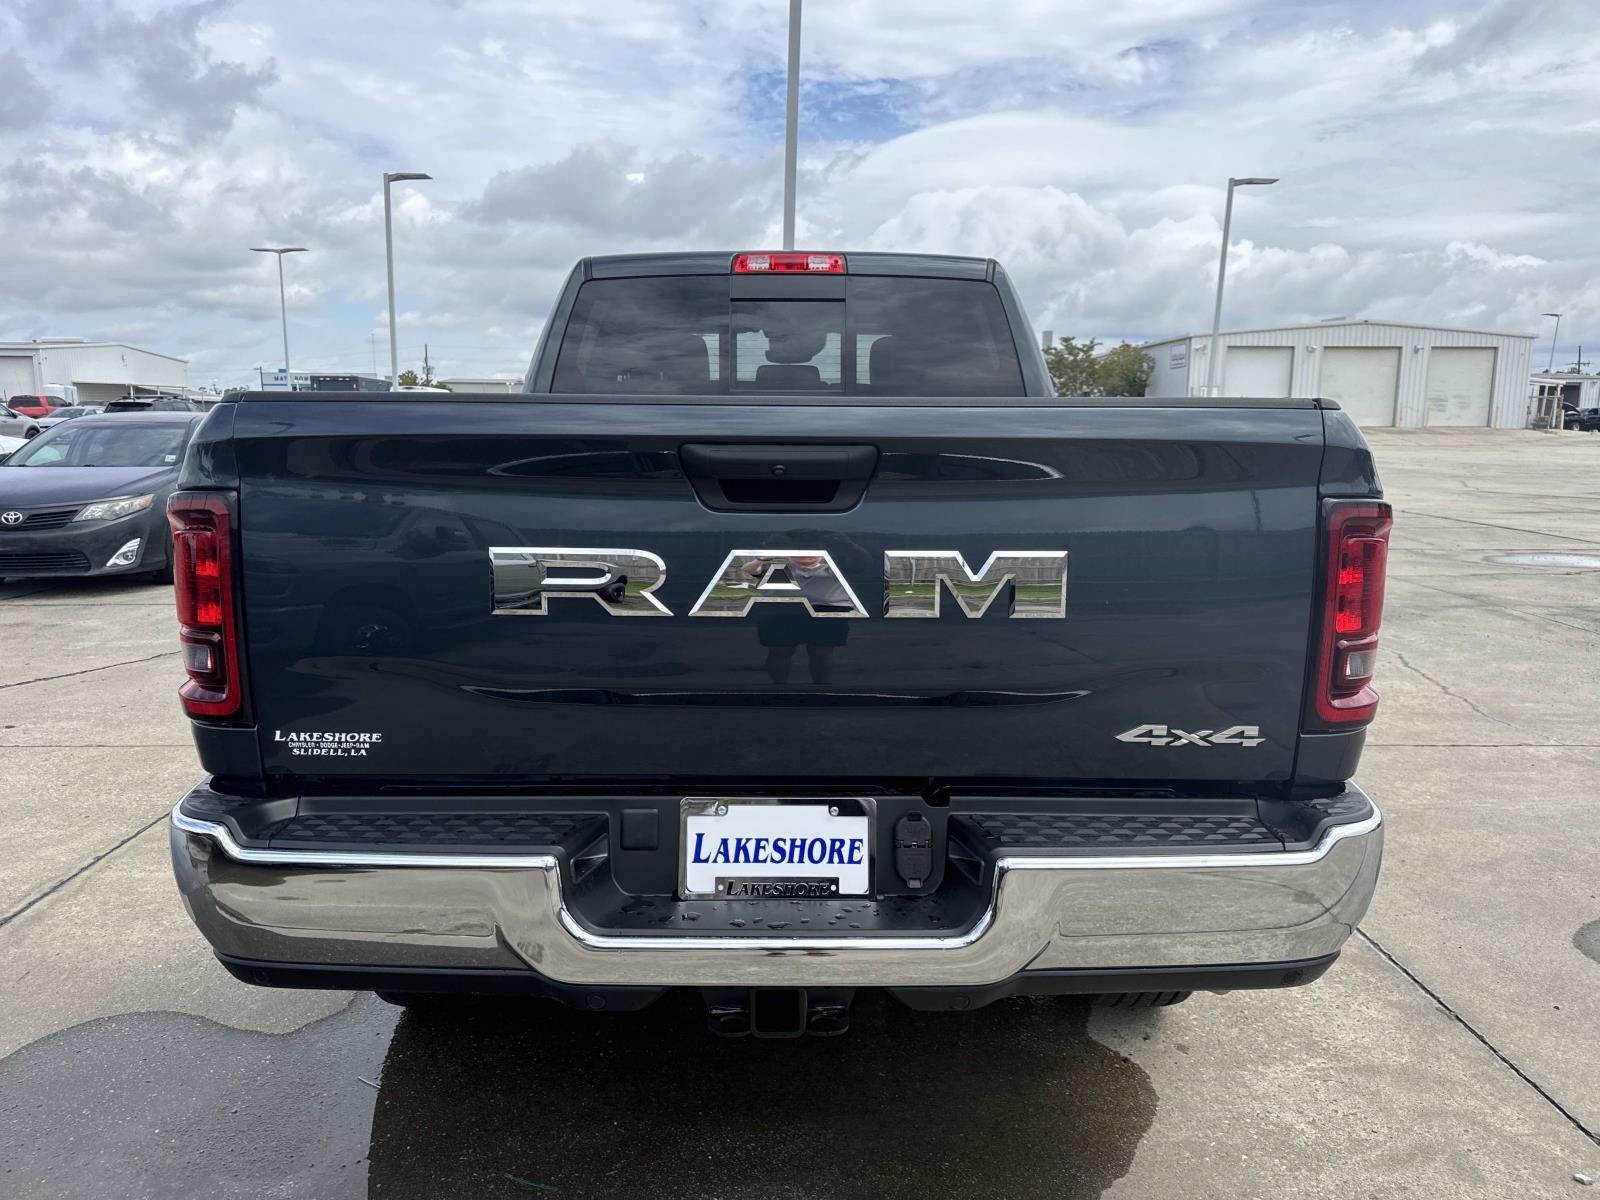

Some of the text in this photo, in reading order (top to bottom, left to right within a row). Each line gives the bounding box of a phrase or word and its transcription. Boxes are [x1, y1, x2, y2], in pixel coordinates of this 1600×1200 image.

[489, 547, 1068, 618] RAM
[274, 730, 382, 742] LAKESHORE
[1114, 724, 1266, 747] 4x4
[350, 748, 367, 756] LA
[692, 833, 863, 864] LAKESHORE
[727, 880, 830, 896] LAKESHORE
